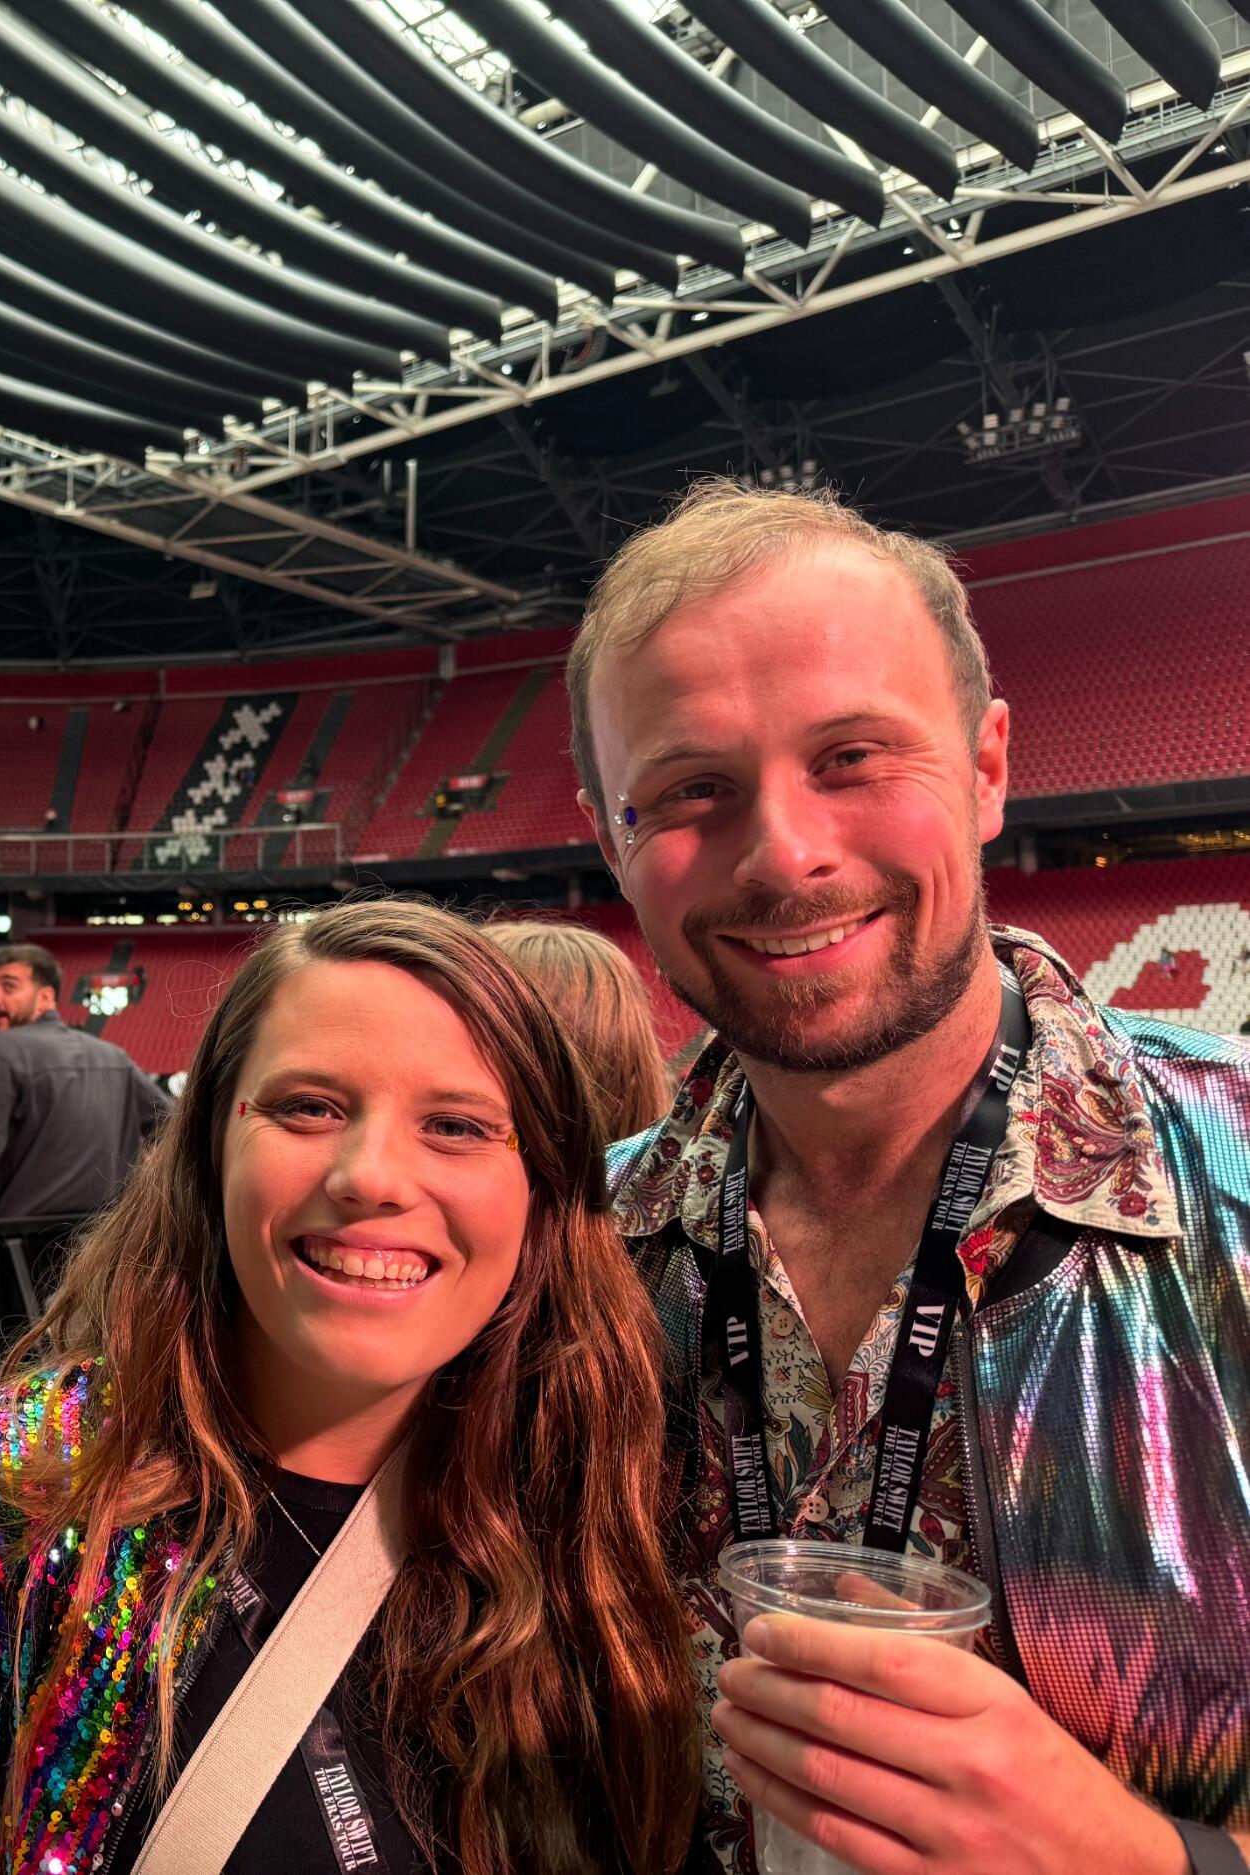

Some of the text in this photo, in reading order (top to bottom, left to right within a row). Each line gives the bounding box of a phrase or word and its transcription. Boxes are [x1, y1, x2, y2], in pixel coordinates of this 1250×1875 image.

[989, 1044, 1021, 1092] VIP
[723, 1171, 740, 1255] TAYLOR SWIFT
[931, 1142, 968, 1230] THE ERAS TOUR
[944, 1145, 992, 1232] TAYLOR SWIFT
[726, 1316, 749, 1367] VIP
[908, 1304, 946, 1357] VIP
[732, 1435, 761, 1533] TAYLOR SWIFT
[751, 1433, 772, 1532] THE ERAS TOUR
[872, 1425, 898, 1526] THE ERAS TOUR
[883, 1427, 920, 1533] TAYLOR SWIFT
[314, 1767, 357, 1871] THE ERAS TOUR
[325, 1763, 378, 1866] TAYLOR SWIFT
